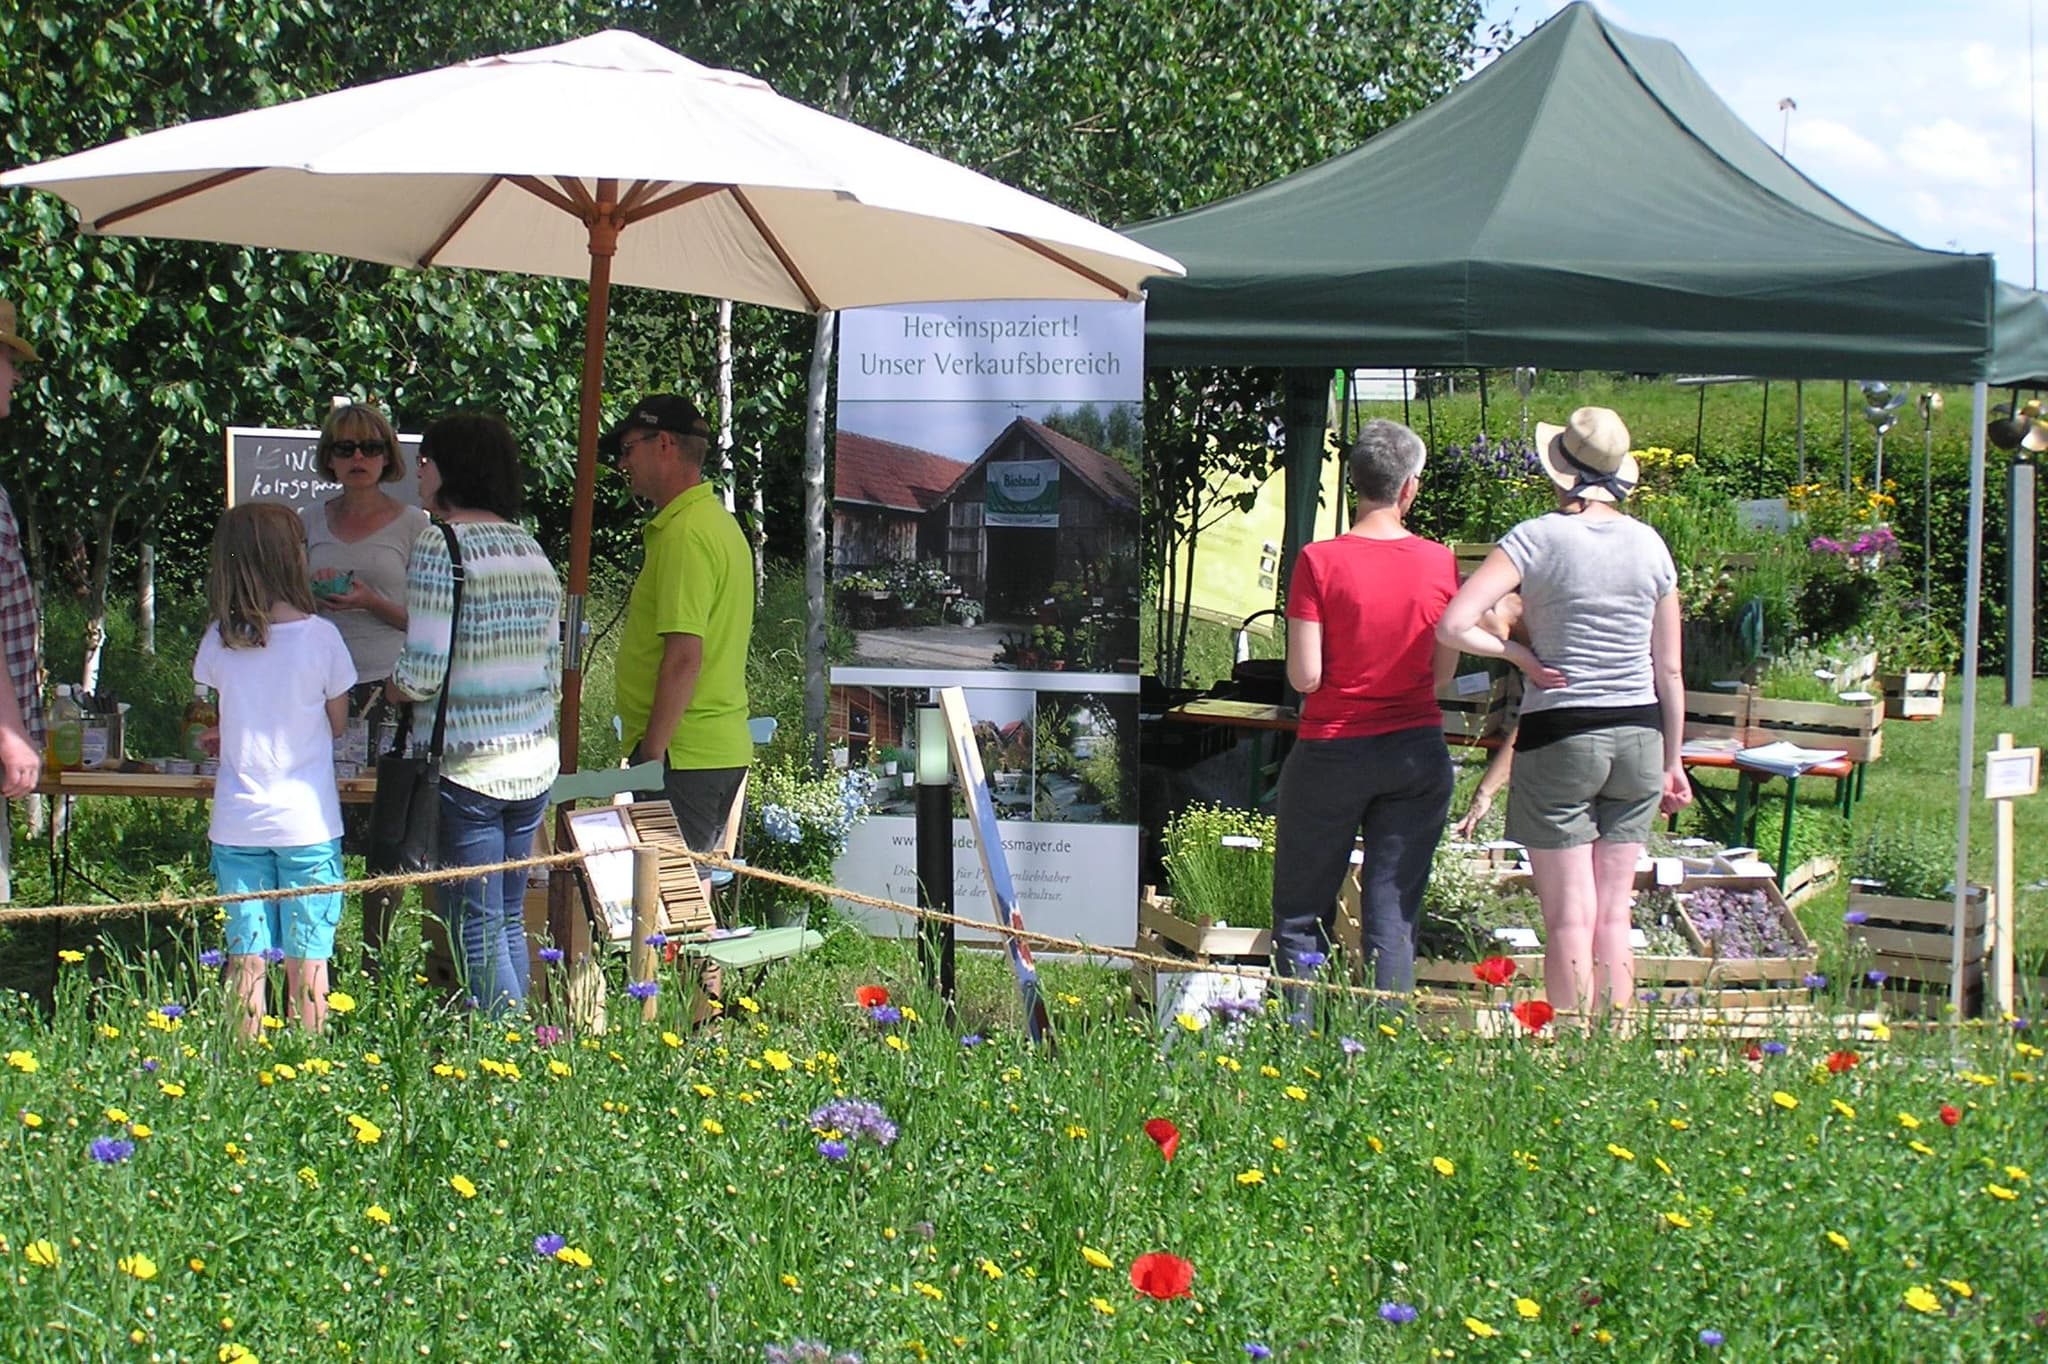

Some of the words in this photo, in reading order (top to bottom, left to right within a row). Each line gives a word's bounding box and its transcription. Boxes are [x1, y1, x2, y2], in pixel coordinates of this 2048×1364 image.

[903, 314, 1079, 343] Hereinspaziert!
[860, 352, 926, 376] Unser
[934, 351, 1121, 376] Verkaufsbereich
[1004, 472, 1041, 488] Bioland
